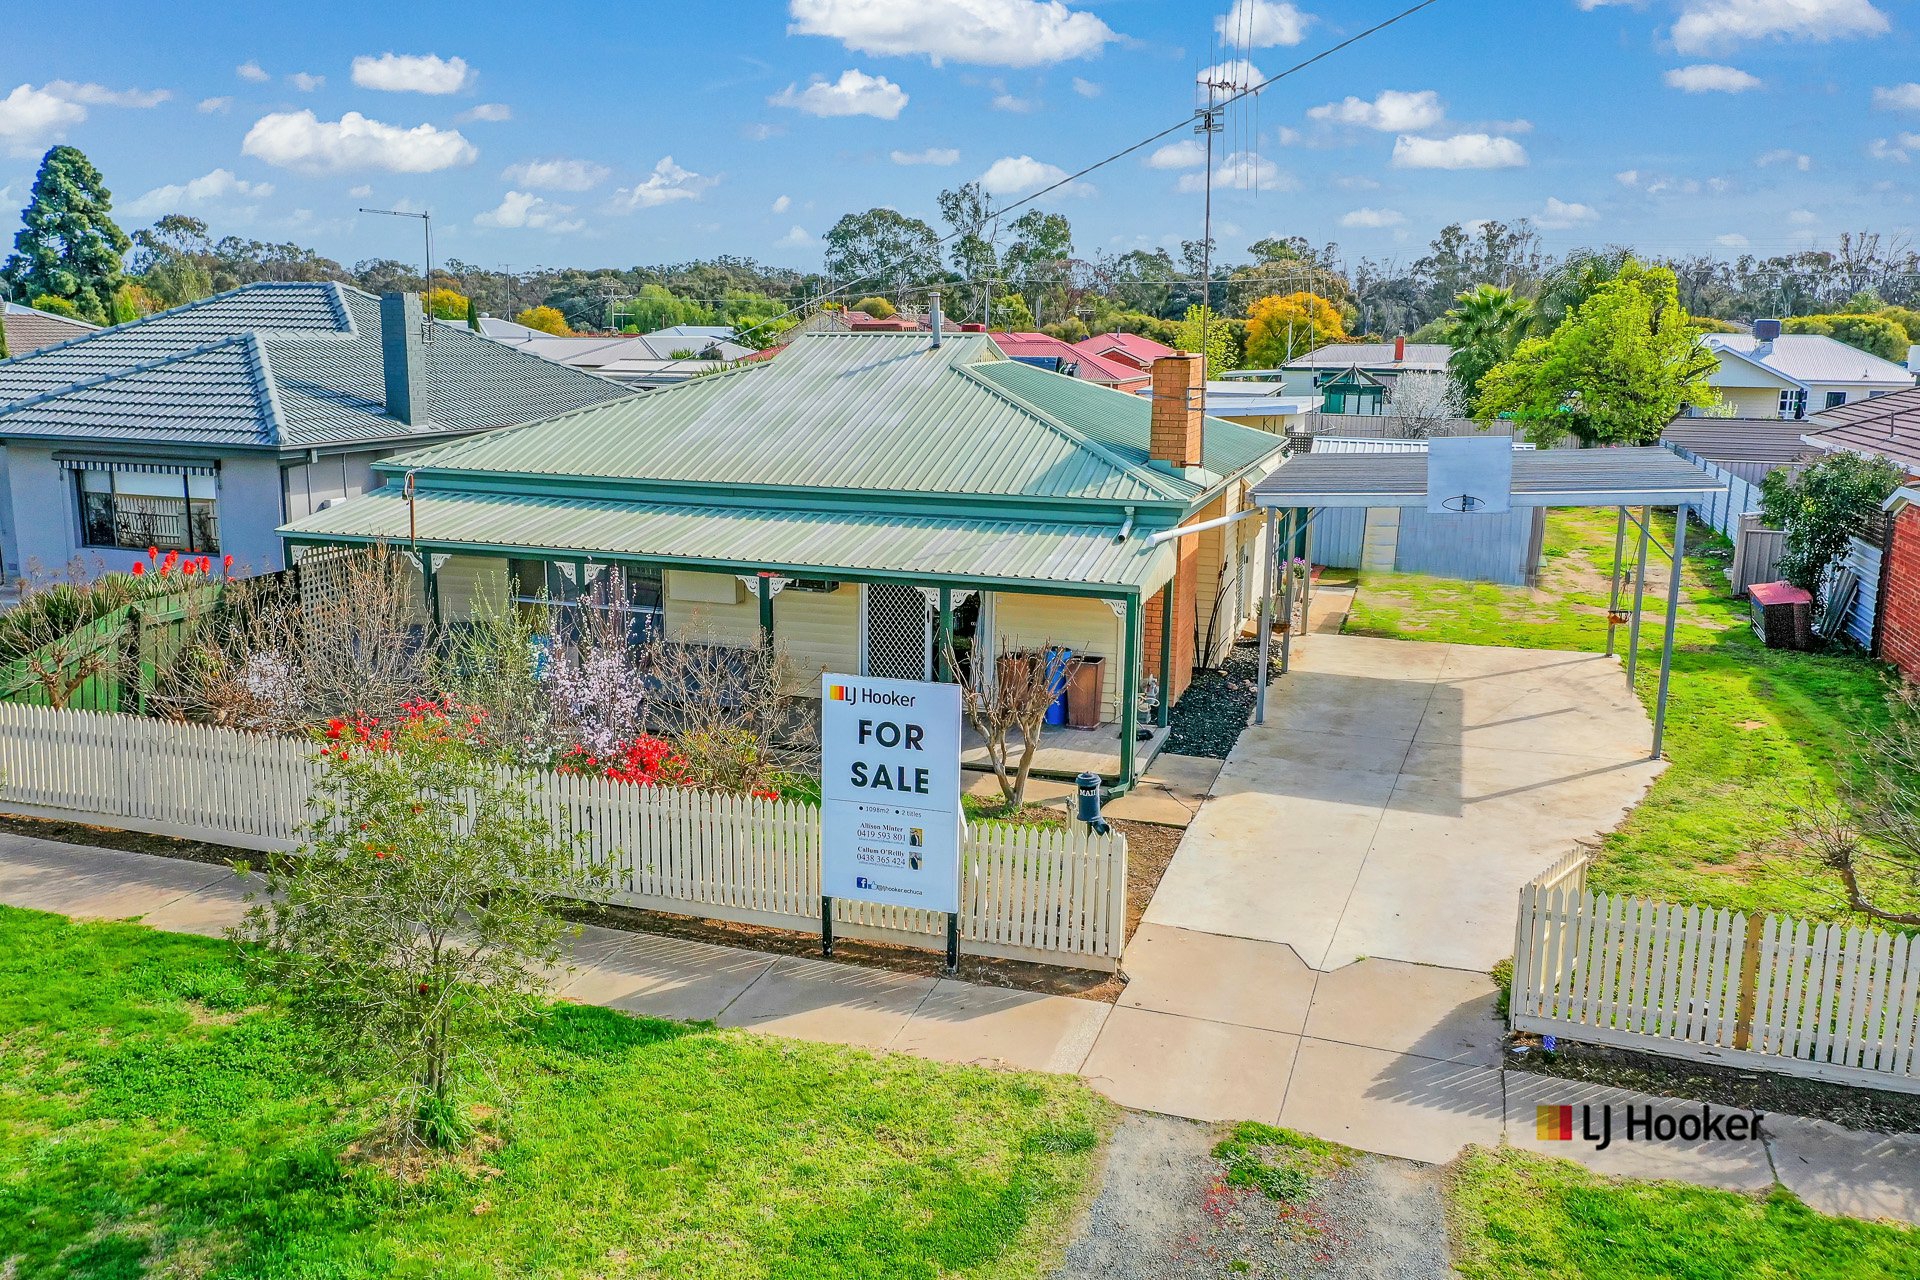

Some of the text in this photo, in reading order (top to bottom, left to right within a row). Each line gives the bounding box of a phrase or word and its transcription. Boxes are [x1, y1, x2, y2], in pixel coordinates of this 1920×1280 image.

[845, 686, 916, 707] LJ Hooker
[858, 719, 925, 751] FOR
[850, 761, 929, 795] SALE
[860, 822, 903, 833] Allison Minter
[857, 829, 875, 838] 0419
[877, 831, 891, 840] 593
[893, 833, 906, 842] 801
[857, 846, 904, 858] Callum O'Reilly
[856, 853, 875, 862] 0438
[877, 856, 890, 864] 365
[892, 857, 906, 866] 424
